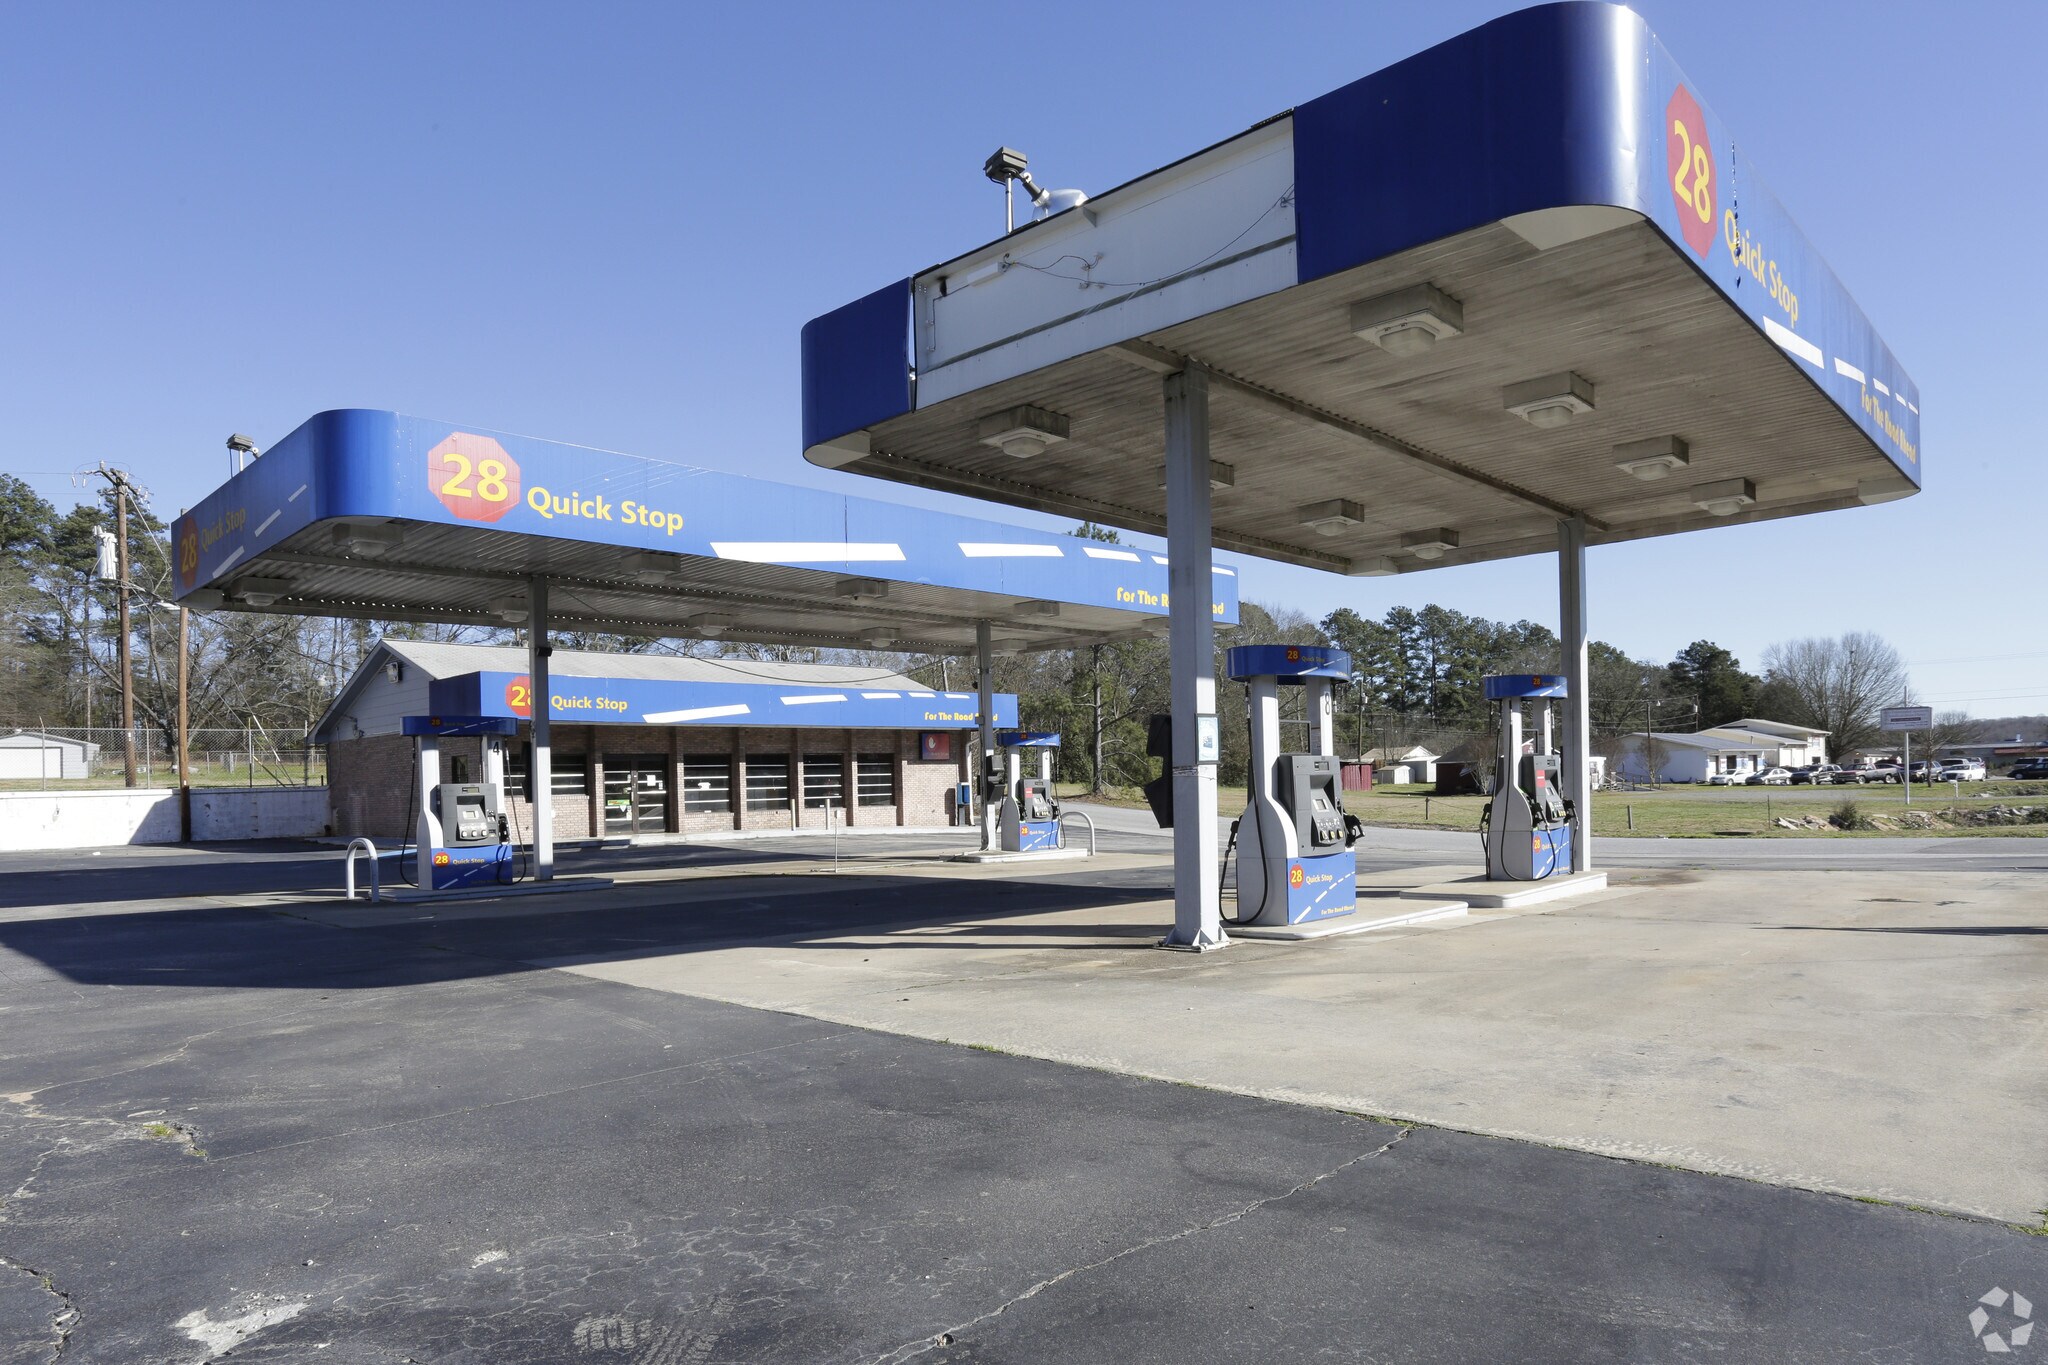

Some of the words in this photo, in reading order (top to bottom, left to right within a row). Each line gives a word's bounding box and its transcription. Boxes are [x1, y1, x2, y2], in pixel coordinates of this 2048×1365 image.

[1674, 119, 1711, 224] 28
[1724, 208, 1766, 288] Quick
[1769, 260, 1798, 329] Stop
[441, 453, 509, 502] 28
[527, 486, 613, 521] Quick
[620, 500, 684, 536] Stop
[201, 515, 224, 553] Quick
[225, 507, 246, 534] Stop
[181, 533, 197, 574] 28
[1116, 586, 1135, 603] For
[1137, 589, 1158, 606] The
[1287, 650, 1299, 660] 28
[551, 695, 592, 711] Quick
[596, 696, 628, 713] Stop
[924, 712, 937, 720] For
[938, 712, 952, 720] The
[954, 712, 974, 721] Road
[493, 741, 499, 755] 4
[435, 855, 449, 864] 28
[1291, 869, 1303, 883] 28
[1306, 874, 1320, 885] Quick
[1321, 873, 1333, 882] Stop
